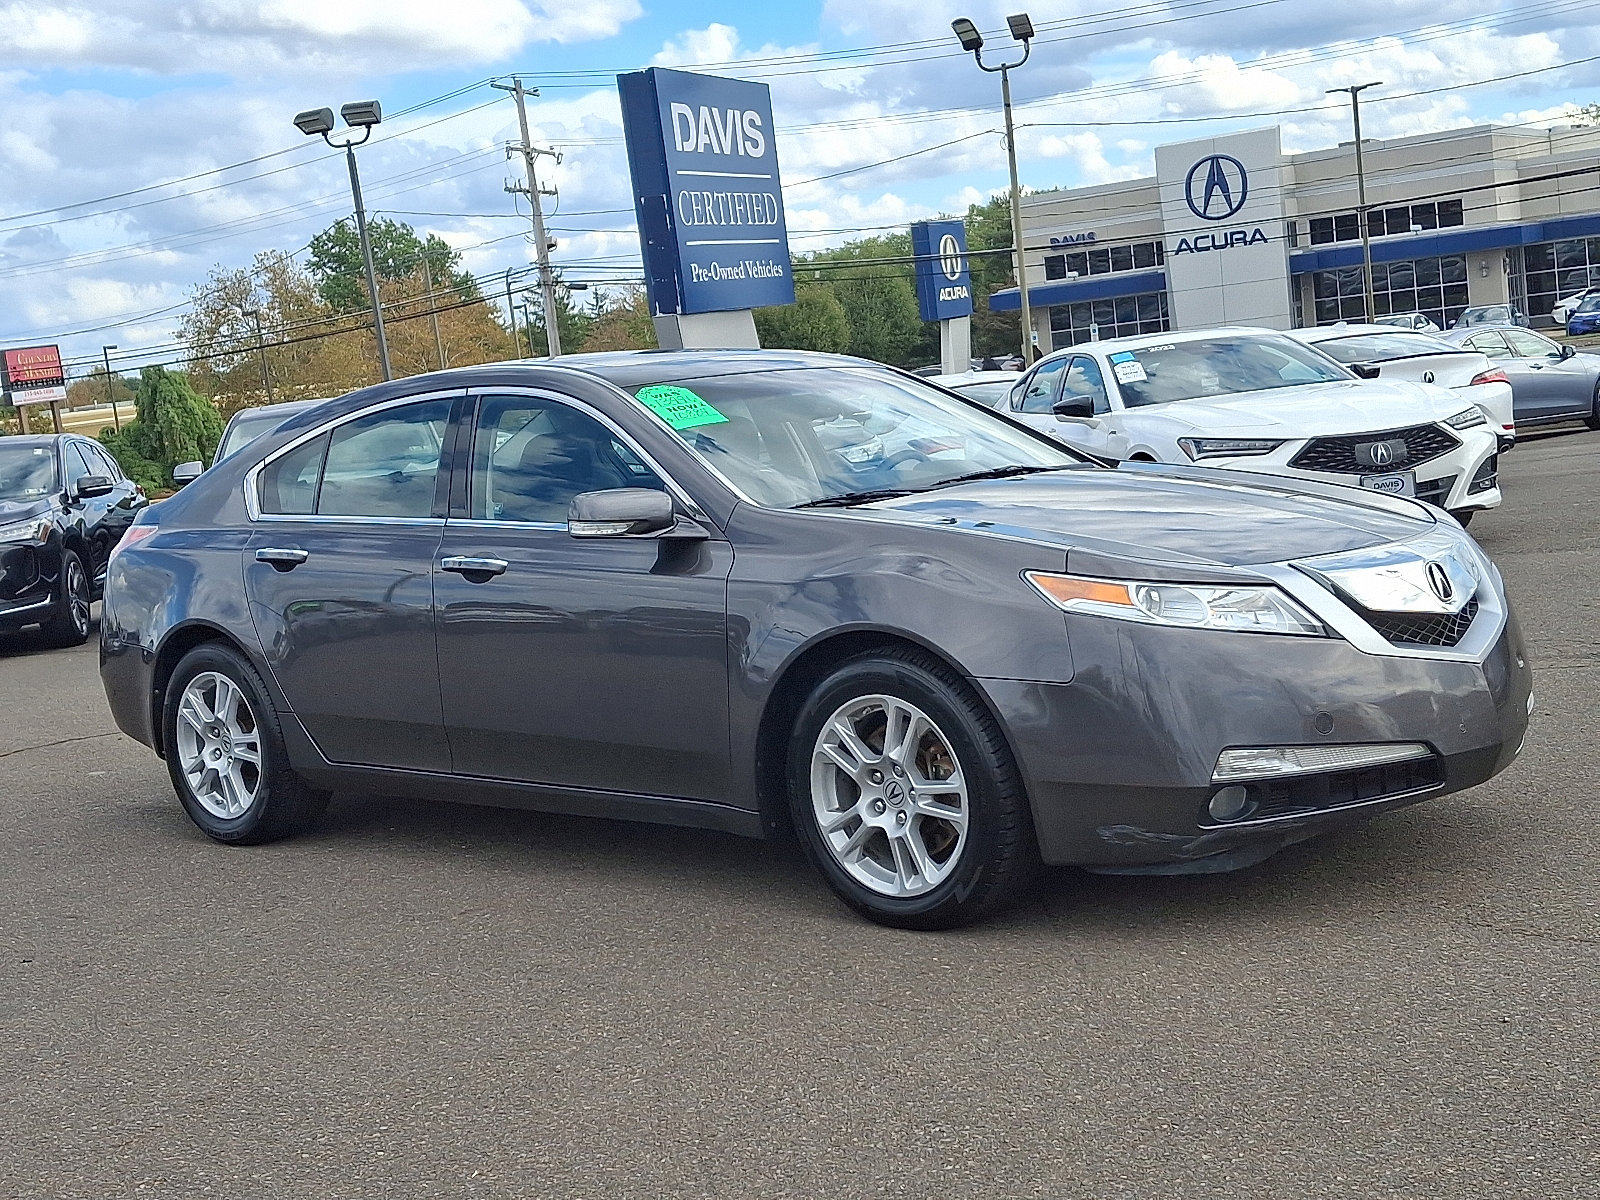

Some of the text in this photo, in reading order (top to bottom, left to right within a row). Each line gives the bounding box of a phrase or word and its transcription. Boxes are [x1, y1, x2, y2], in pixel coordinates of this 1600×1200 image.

[670, 102, 765, 158] DAVIS
[678, 190, 778, 226] CERTIFIED
[1049, 231, 1097, 251] DAVIS
[1174, 227, 1268, 256] ACURA
[690, 259, 783, 283] Pre-Owned Vehicles
[939, 286, 969, 301] ACURA
[1374, 481, 1399, 489] DAVIS
